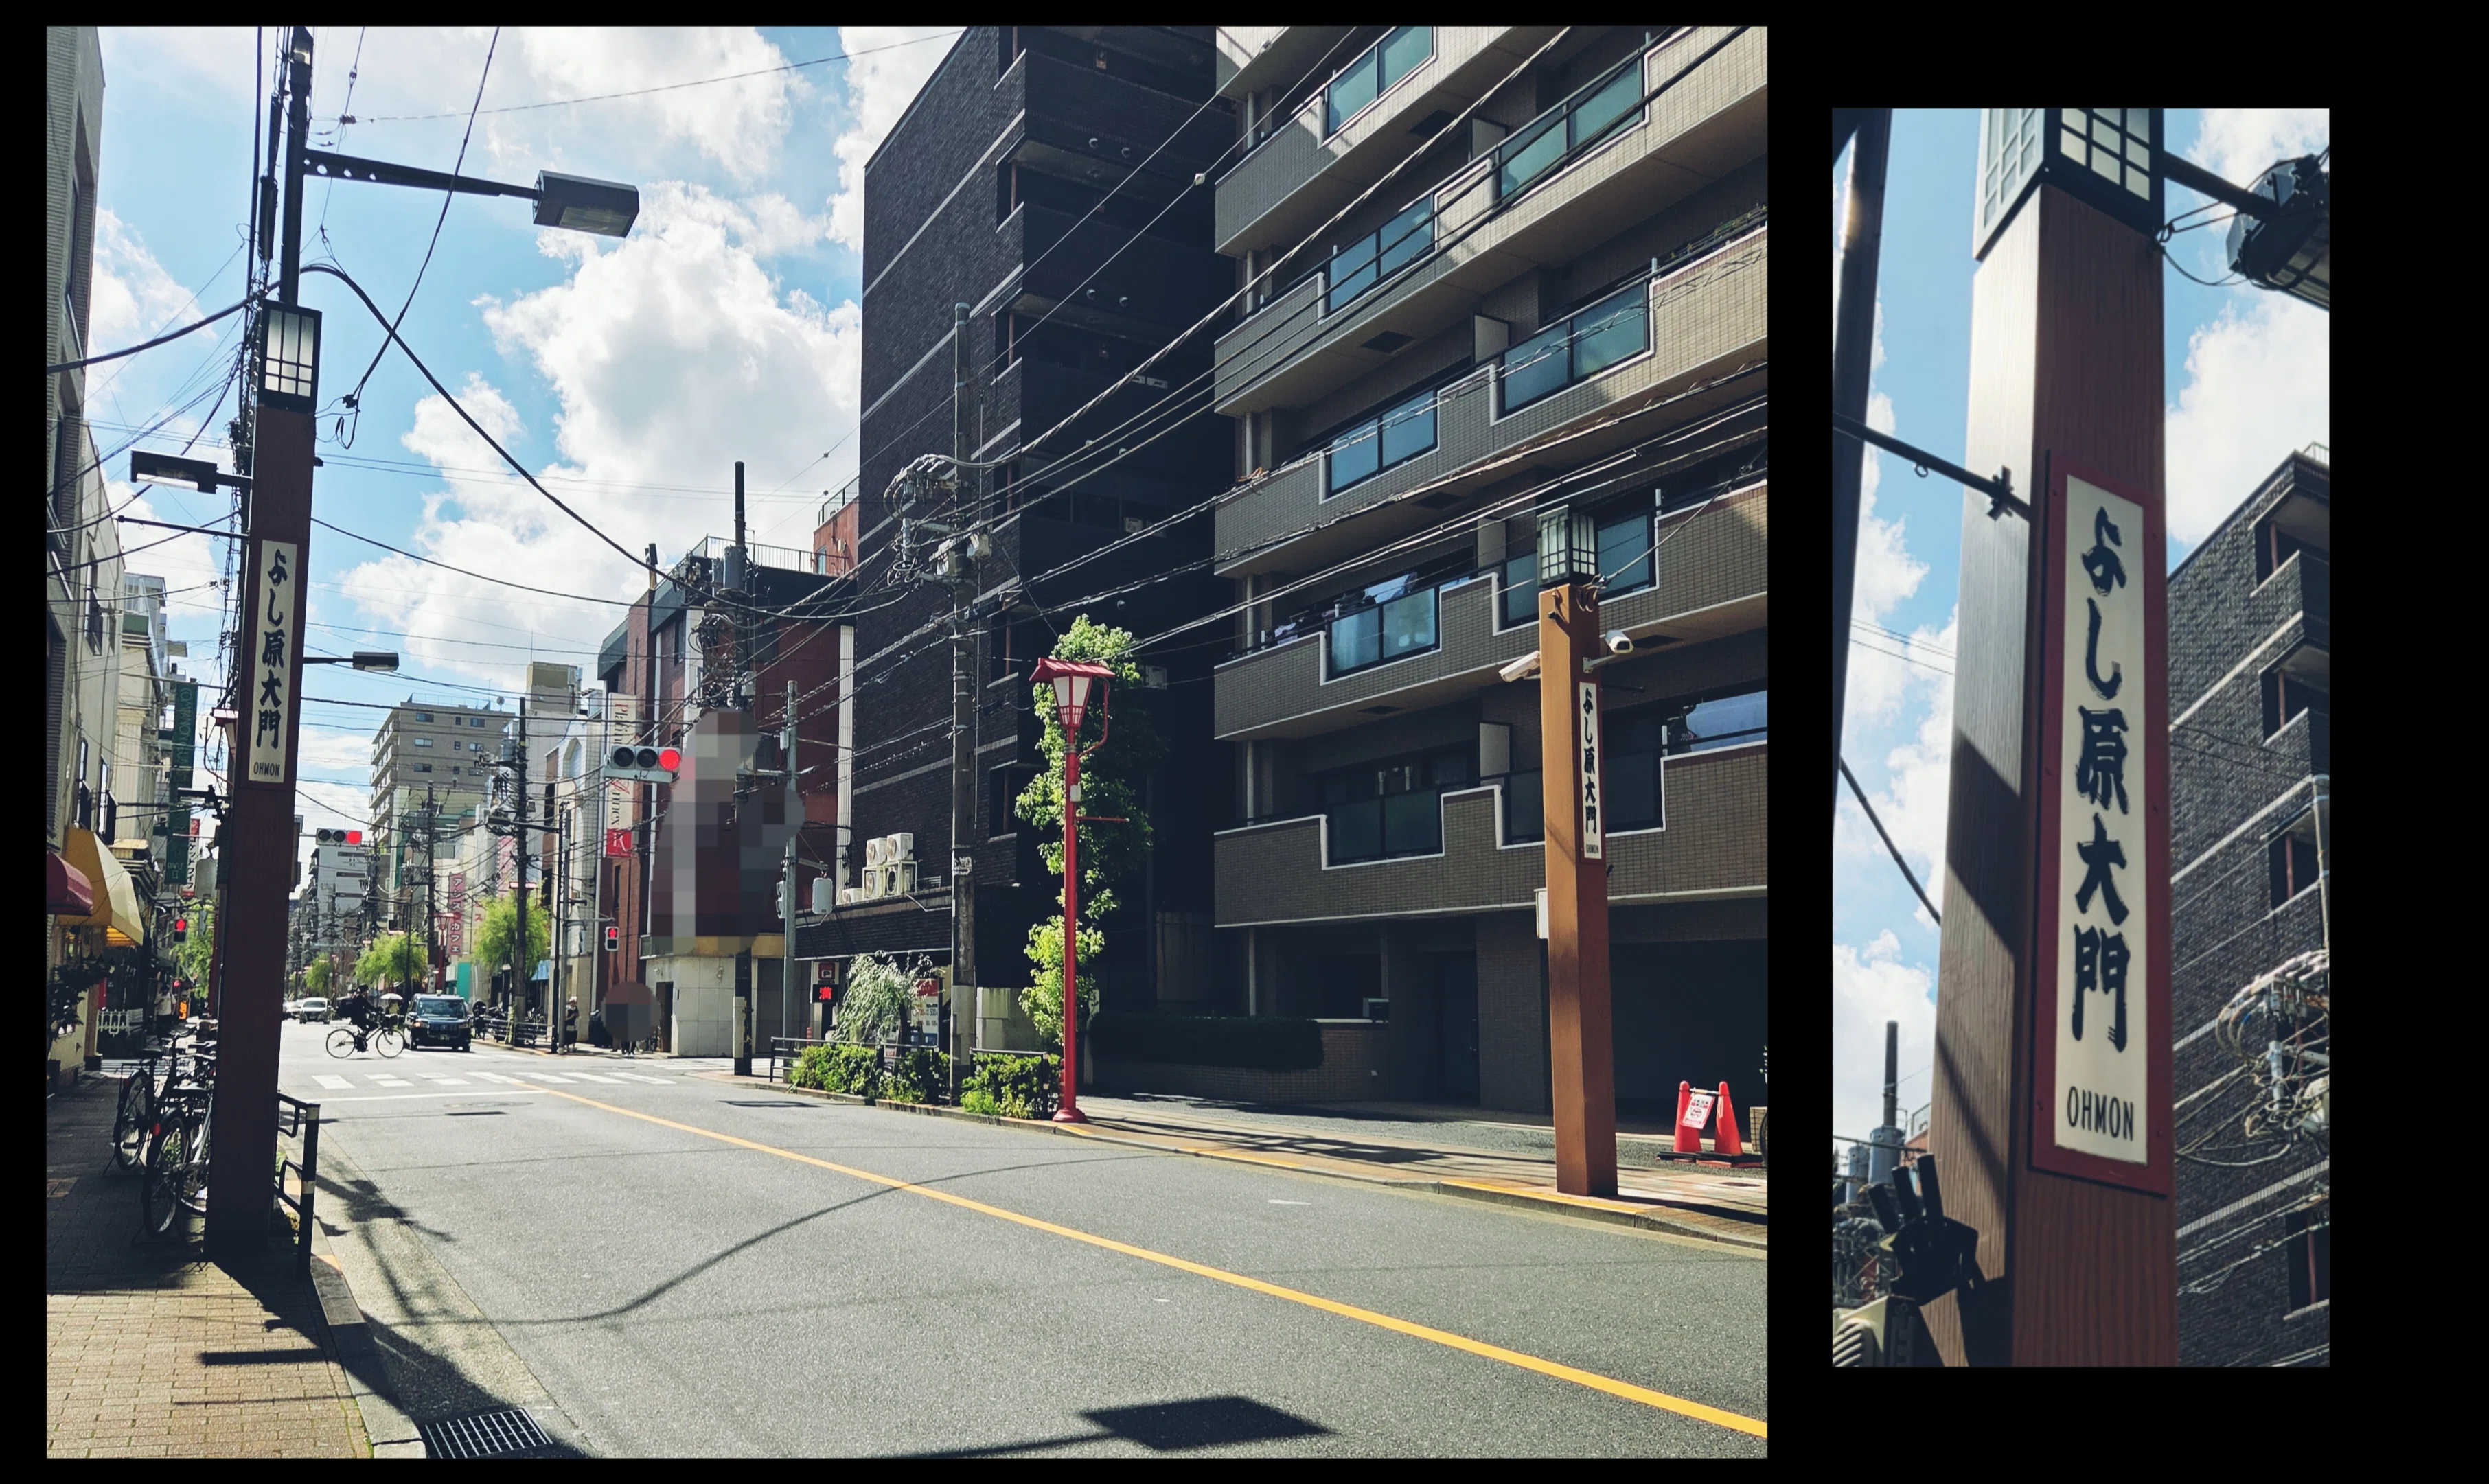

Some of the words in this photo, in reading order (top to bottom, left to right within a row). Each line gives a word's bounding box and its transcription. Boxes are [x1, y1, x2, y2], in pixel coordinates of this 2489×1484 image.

[256, 548, 288, 750] よし原大門
[253, 761, 280, 777] OHMON
[1583, 688, 1596, 834] よし原大門
[2072, 506, 2130, 1053] よし原大門
[2067, 1086, 2133, 1141] OHMON
